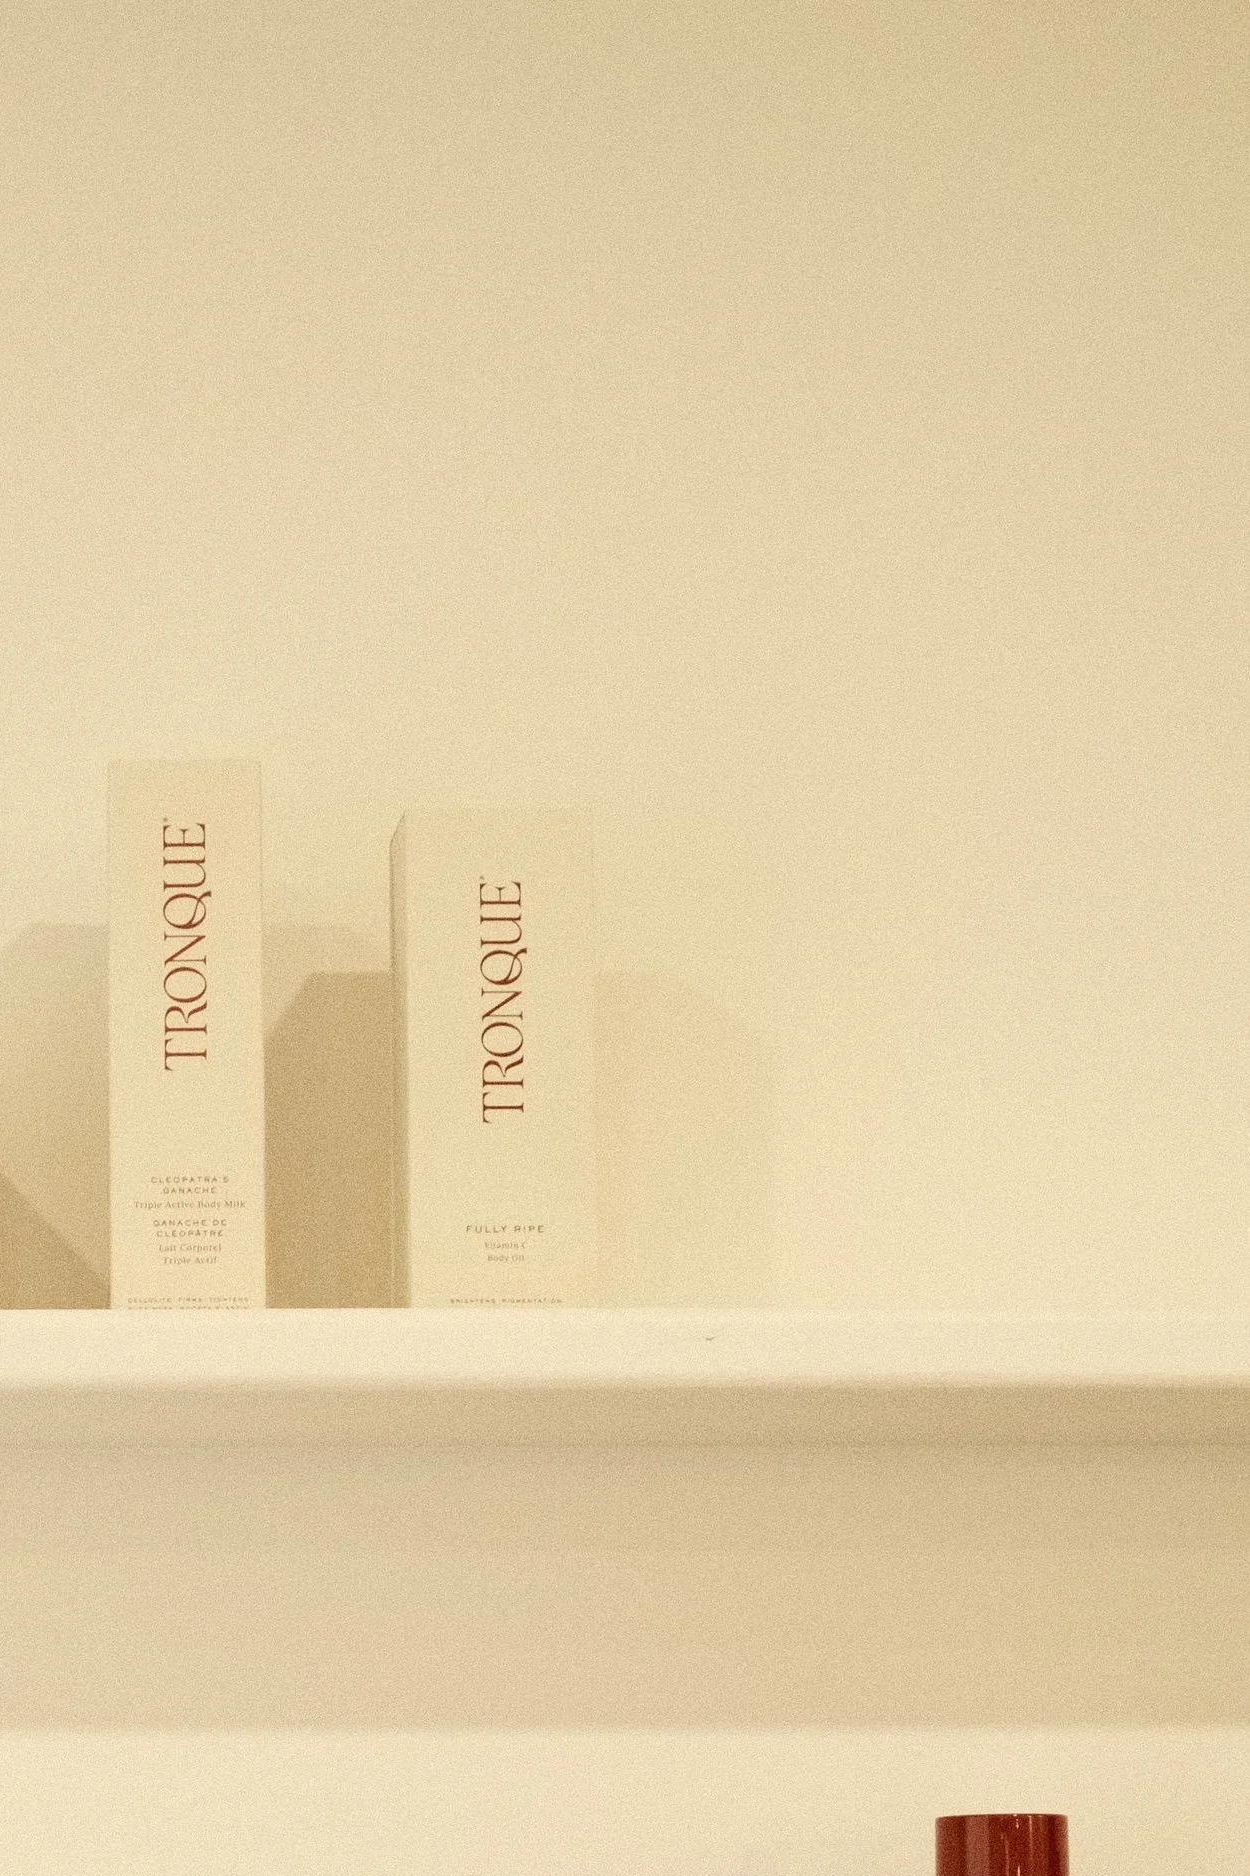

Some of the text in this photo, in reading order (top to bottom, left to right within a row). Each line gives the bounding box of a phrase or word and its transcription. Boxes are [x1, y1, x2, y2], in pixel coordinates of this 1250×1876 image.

[162, 822, 212, 1072] TRONQUE
[479, 881, 528, 1124] TRONQUE
[465, 1225, 545, 1234] FULLY RIPE
